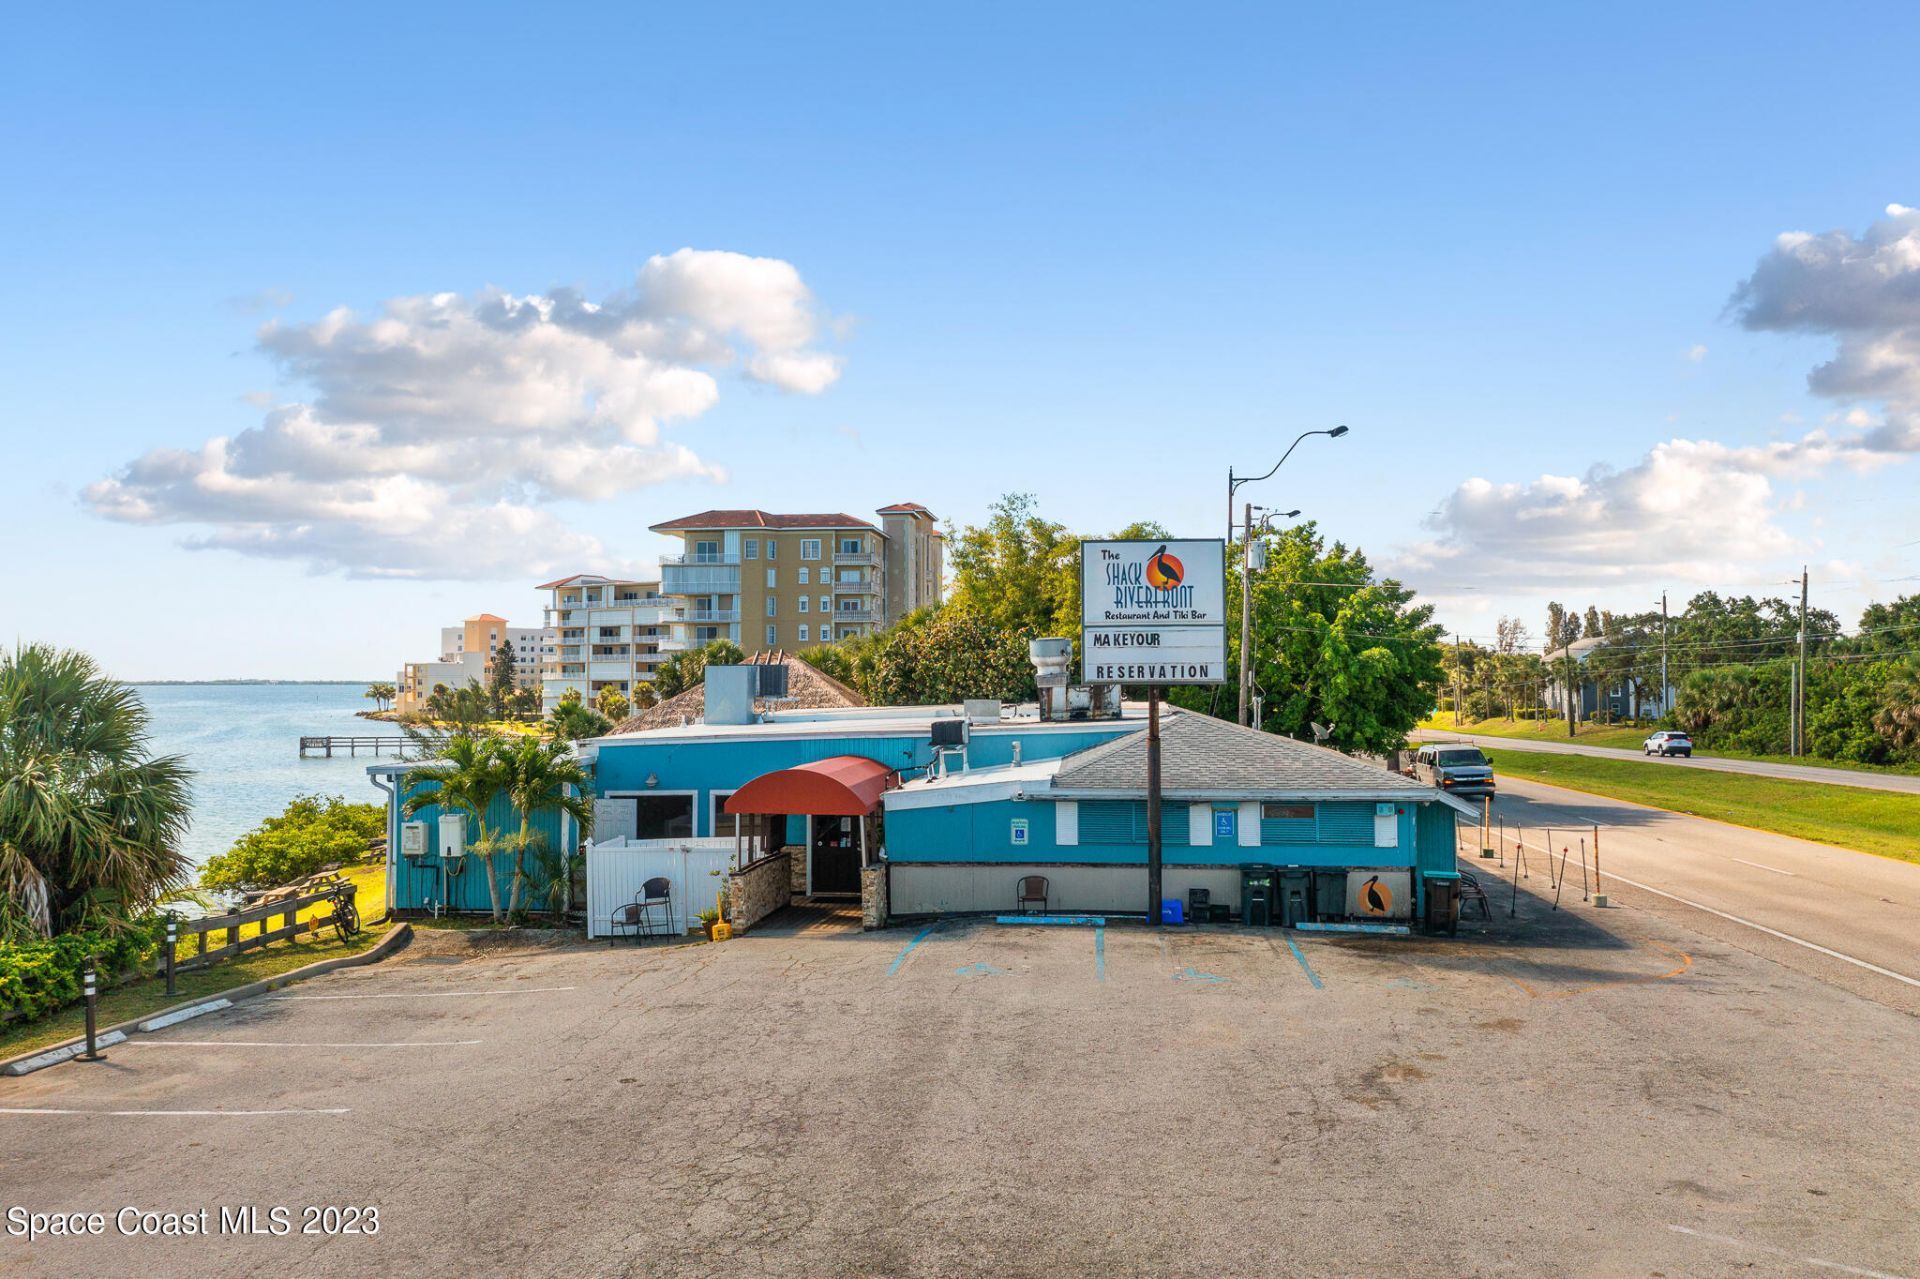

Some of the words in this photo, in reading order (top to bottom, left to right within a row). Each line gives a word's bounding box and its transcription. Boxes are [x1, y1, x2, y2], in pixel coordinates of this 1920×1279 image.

[1101, 549, 1121, 560] The
[1106, 562, 1142, 586] SHACK
[1113, 585, 1195, 609] RIVERFRONT
[1104, 611, 1151, 620] Restaurant
[1152, 610, 1170, 620] And
[1173, 610, 1189, 620] Tiki
[1191, 610, 1207, 620] Bar
[1096, 664, 1209, 679] RESERVATION
